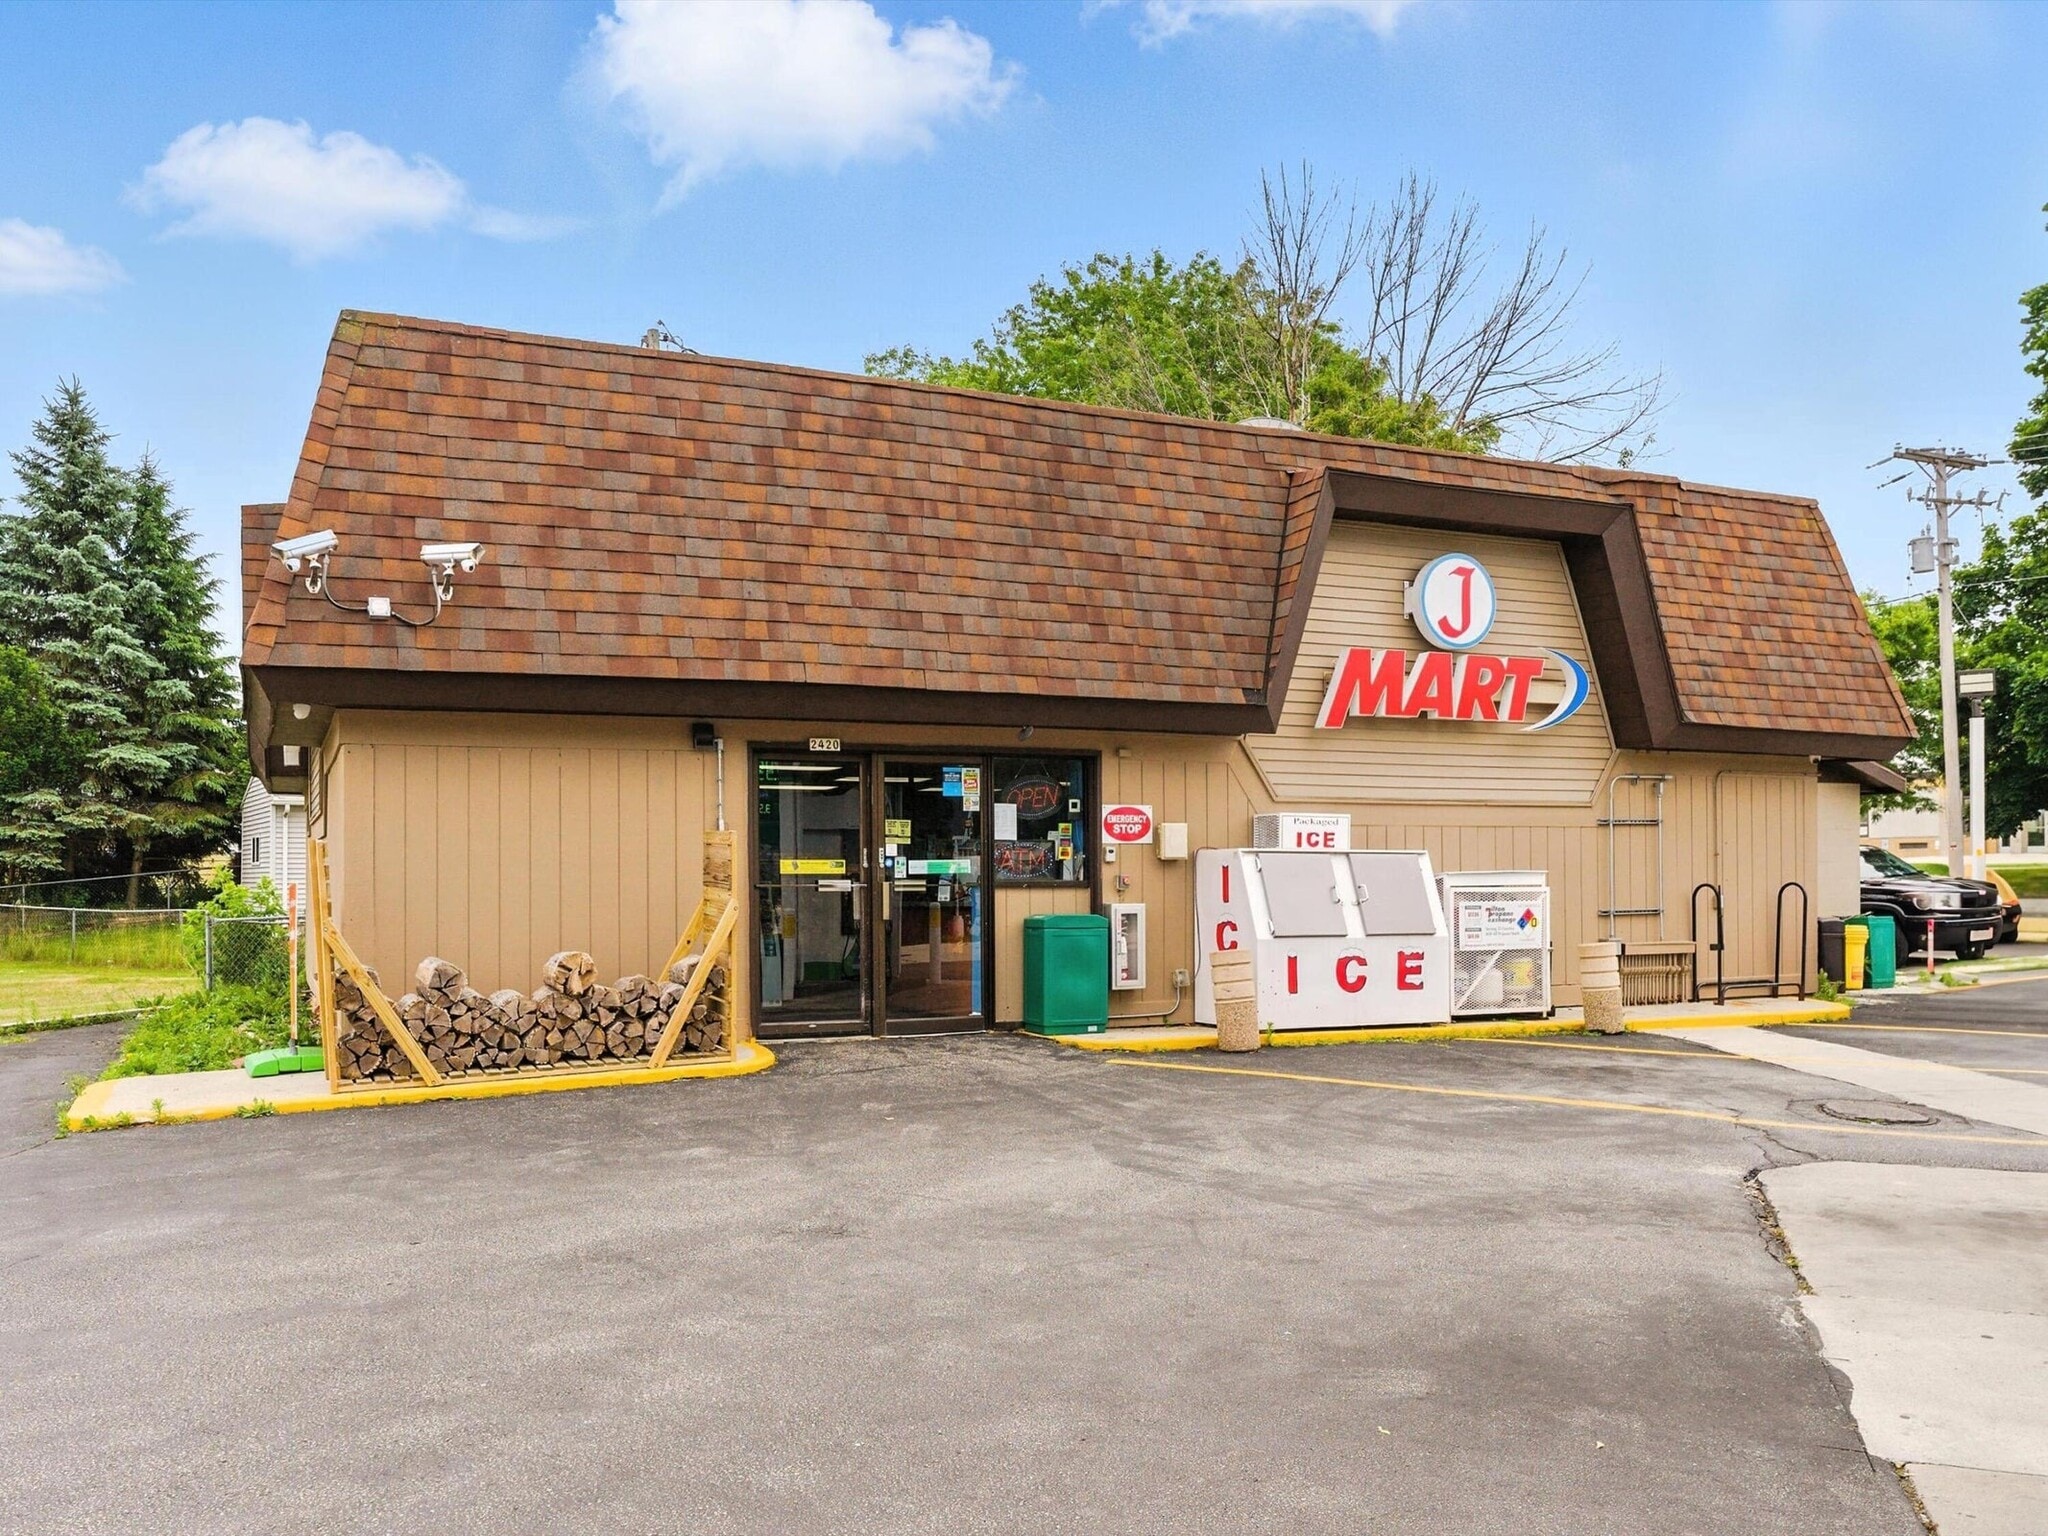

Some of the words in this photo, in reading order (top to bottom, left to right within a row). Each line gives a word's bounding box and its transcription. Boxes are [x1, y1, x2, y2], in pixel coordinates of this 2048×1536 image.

[1437, 566, 1476, 638] J
[1317, 646, 1545, 729] MART
[810, 739, 840, 750] 2420
[1006, 784, 1059, 809] OPEN
[1106, 814, 1147, 824] EMERGENCY
[1112, 824, 1142, 834] STOP
[1293, 818, 1339, 827] Packaged
[1296, 831, 1336, 849] ICE
[1001, 848, 1045, 873] ATM
[1216, 864, 1238, 951] IC
[1287, 950, 1425, 995] ICE
